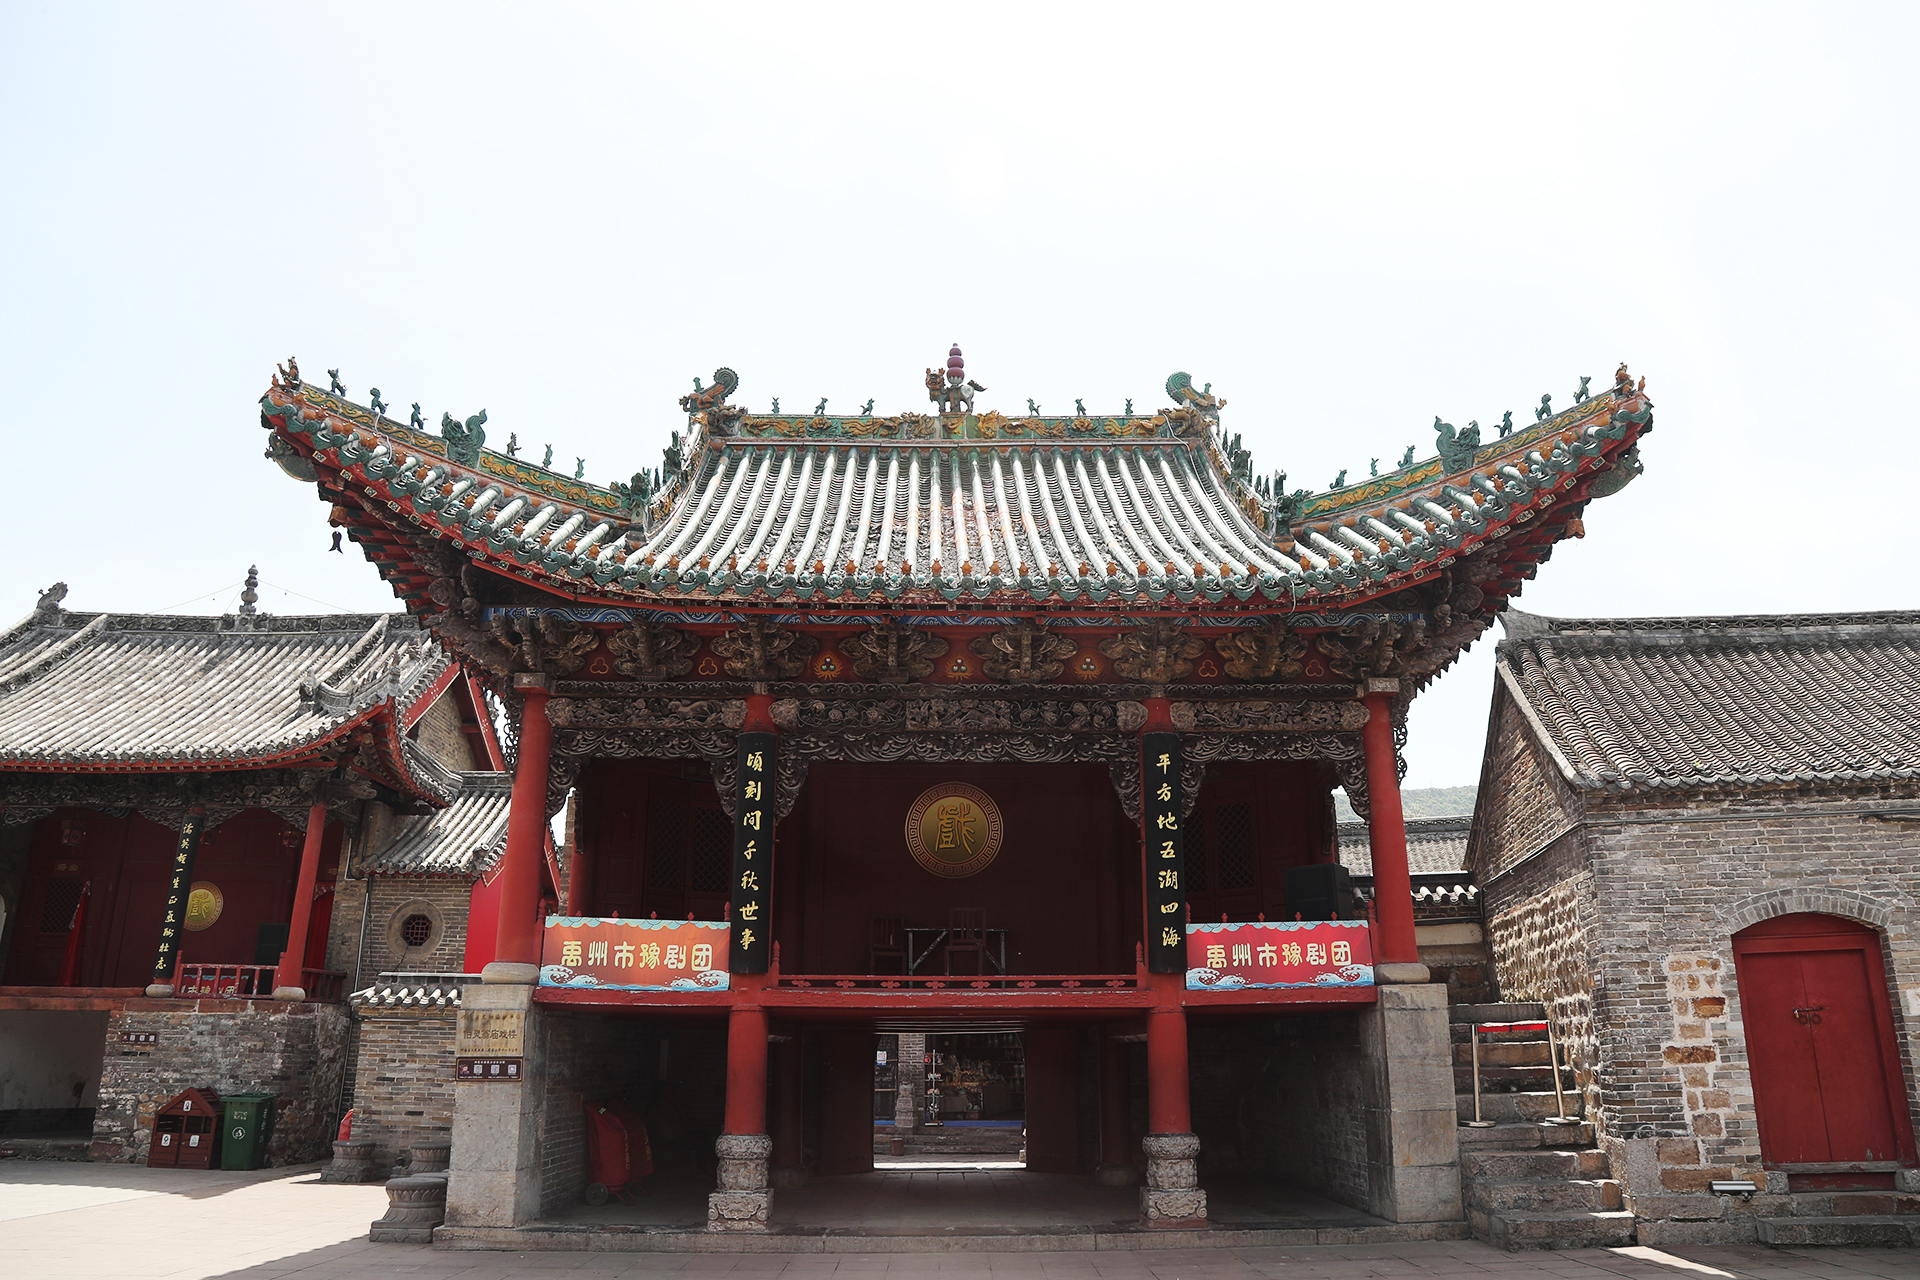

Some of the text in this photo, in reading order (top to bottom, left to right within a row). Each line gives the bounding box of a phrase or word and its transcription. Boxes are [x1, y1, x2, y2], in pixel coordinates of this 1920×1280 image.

[561, 940, 713, 972] 禹州市豫剧团
[1206, 940, 1352, 969] 禹州市豫剧团
